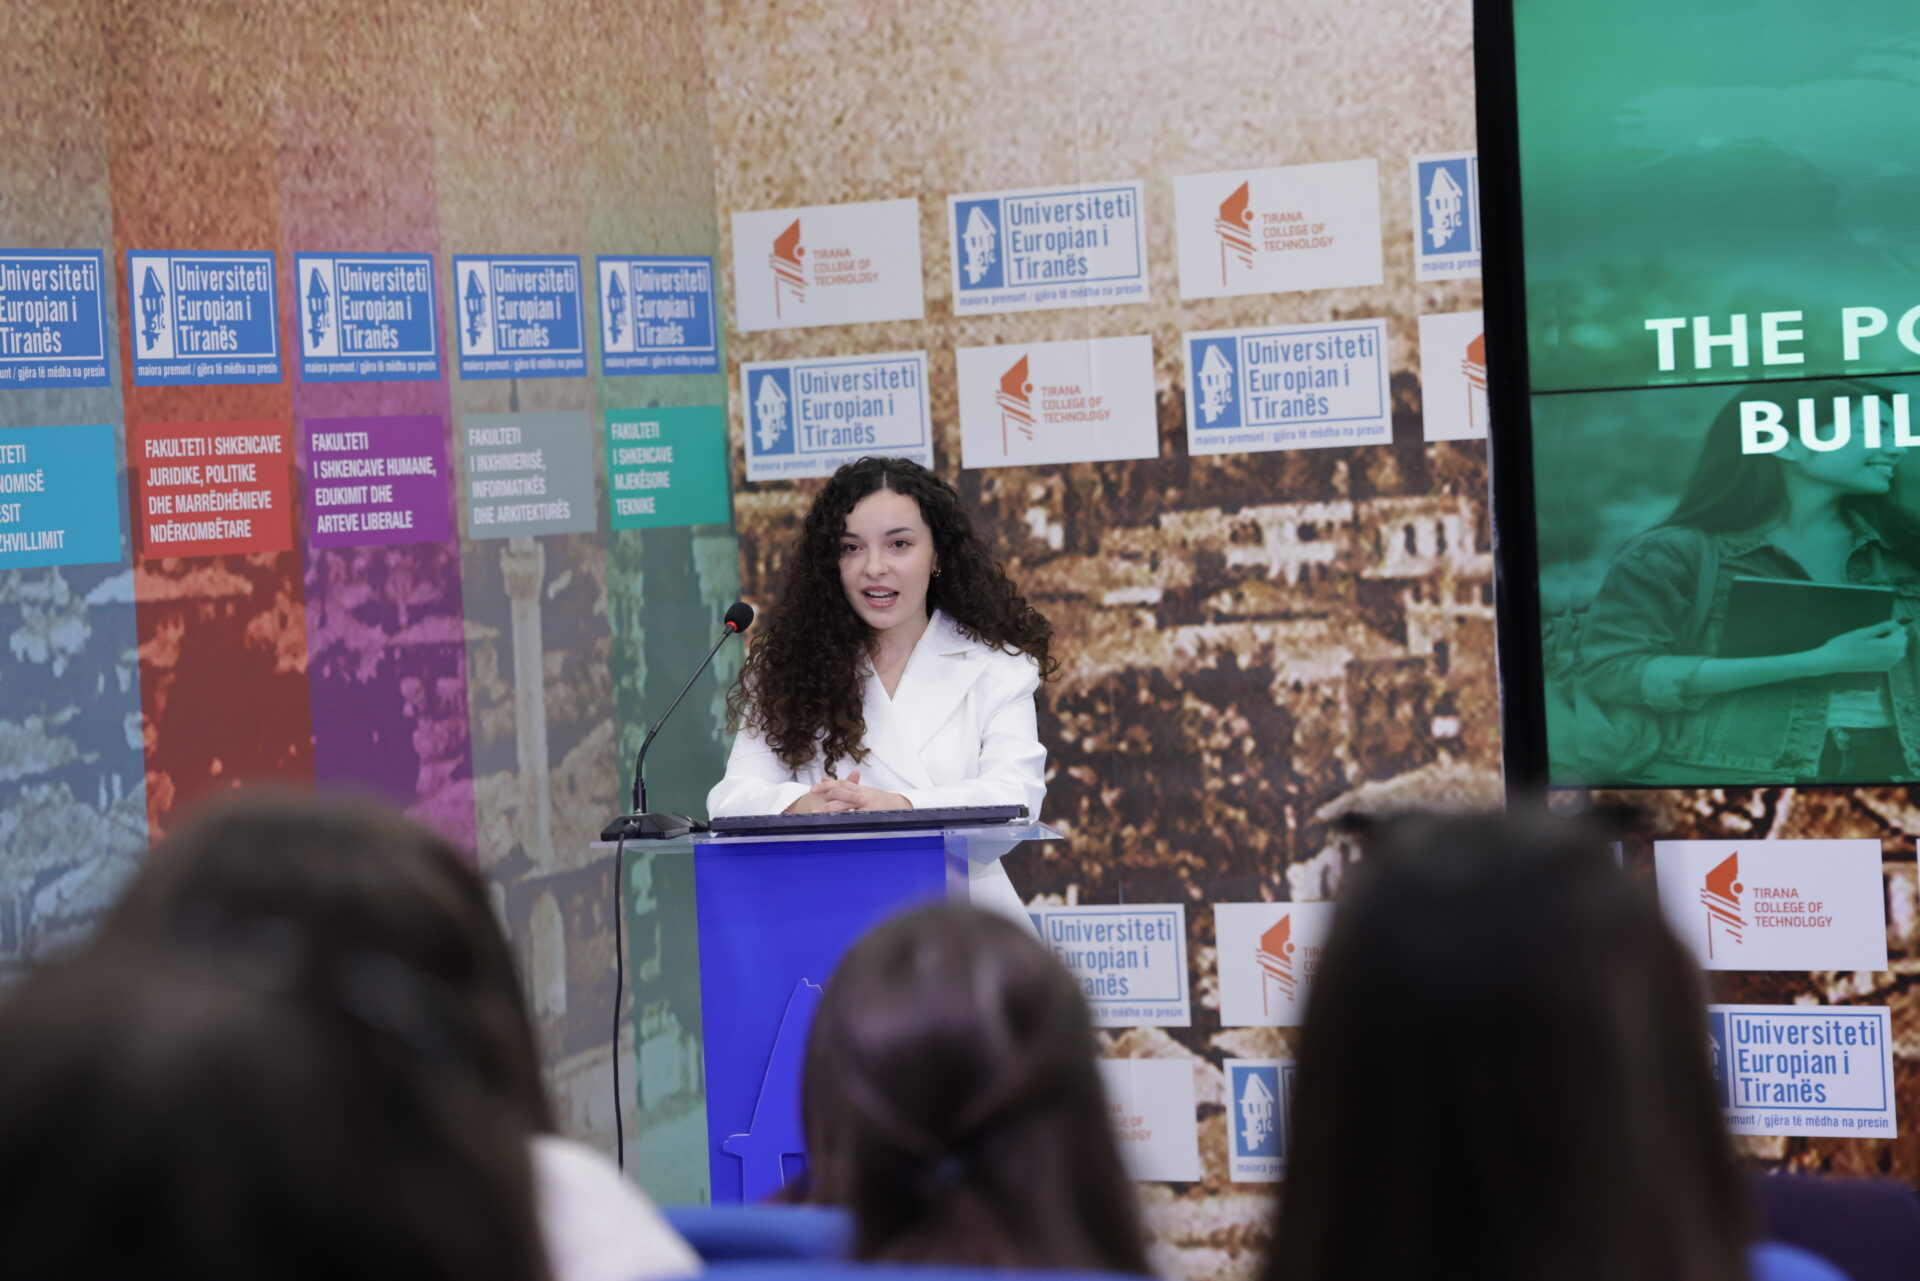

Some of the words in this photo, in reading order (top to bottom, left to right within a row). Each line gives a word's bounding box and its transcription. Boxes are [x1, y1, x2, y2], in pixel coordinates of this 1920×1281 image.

[1009, 194, 1131, 226] Universiteti
[1262, 212, 1303, 224] TIRANA
[1011, 227, 1098, 255] Europian
[1102, 223, 1108, 246] i
[1262, 225, 1309, 239] COLLEGE
[1311, 223, 1326, 234] OF
[1263, 236, 1334, 251] TECHNOLOGY
[813, 247, 852, 260] TIRANA
[175, 264, 267, 292] Universiteti
[340, 266, 427, 292] Universiteti
[813, 261, 857, 274] COLLEGE
[858, 259, 871, 270] OF
[815, 272, 879, 286] TECHNOLOGY
[1013, 254, 1089, 280] Tiranës
[494, 268, 575, 292] Universiteti
[634, 268, 708, 292] Universiteti
[0, 295, 69, 328] Europian
[72, 295, 77, 322] i
[178, 295, 243, 327] Europian
[245, 295, 252, 321] i
[341, 296, 405, 325] Europian
[406, 296, 412, 320] i
[497, 296, 554, 325] Europian
[556, 296, 561, 319] i
[636, 295, 688, 323] Europian
[690, 295, 695, 318] i
[0, 326, 62, 354] Tiranës
[179, 325, 238, 351] Tiranës
[343, 324, 399, 350] Tiranës
[498, 323, 550, 348] Tiranës
[638, 321, 685, 345] Tiranës
[1645, 310, 1805, 371] THE
[1248, 333, 1374, 365] Universiteti
[800, 365, 915, 395] Universiteti
[1041, 385, 1081, 397] TIRANA
[1249, 366, 1338, 394] Europian
[1344, 363, 1350, 387] i
[802, 396, 884, 423] Europian
[888, 393, 894, 416] i
[1042, 398, 1085, 411] COLLEGE
[1088, 396, 1103, 407] OF
[1251, 393, 1329, 420] Tiranës
[1043, 410, 1111, 424] TECHNOLOGY
[1739, 393, 1920, 455] BUIL
[145, 438, 205, 458] FAKULTETI
[208, 438, 212, 456] I
[215, 435, 281, 456] SHKENCAVE
[312, 432, 368, 452] FAKULTETI
[468, 427, 521, 446] FAKULTETI
[803, 423, 876, 448] Tiranës
[0, 444, 26, 464] TETI
[147, 465, 204, 488] JURIDIKE,
[206, 463, 257, 484] POLITIKE
[314, 461, 318, 479] I
[320, 458, 385, 479] SHKENCAVE
[387, 456, 436, 478] HUMANE,
[315, 485, 368, 506] EDUKIMIT
[370, 484, 393, 504] DHE
[472, 474, 546, 499] INFORMATIKËS
[0, 503, 21, 523] SIT
[148, 495, 172, 515] DHE
[175, 488, 272, 514] MARRËDHËNIEVE
[474, 506, 495, 525] DHE
[497, 498, 571, 524] ARKITEKTURËS
[150, 516, 252, 543] NDËRKOMBËTARE
[317, 513, 359, 534] ARTEVE
[361, 510, 413, 532] LIBERALE
[1753, 887, 1799, 899] TIRANA
[1754, 902, 1805, 913] COLLEGE
[1808, 902, 1823, 913] OF
[1051, 918, 1172, 943] Universiteti
[1755, 916, 1833, 927] TECHNOLOGY
[1143, 945, 1149, 968] i
[1302, 946, 1322, 959] TIR
[1079, 973, 1129, 996] anës
[1736, 1019, 1876, 1046] Universiteti
[1738, 1049, 1837, 1079] Europian
[1843, 1050, 1850, 1075] i
[1740, 1077, 1827, 1104] Tiranës
[1725, 1114, 1755, 1126] emunt
[1764, 1114, 1790, 1128] gjëra
[1792, 1114, 1802, 1126] të
[1805, 1115, 1839, 1128] mëdha
[1842, 1118, 1854, 1128] na
[1857, 1116, 1889, 1130] presin
